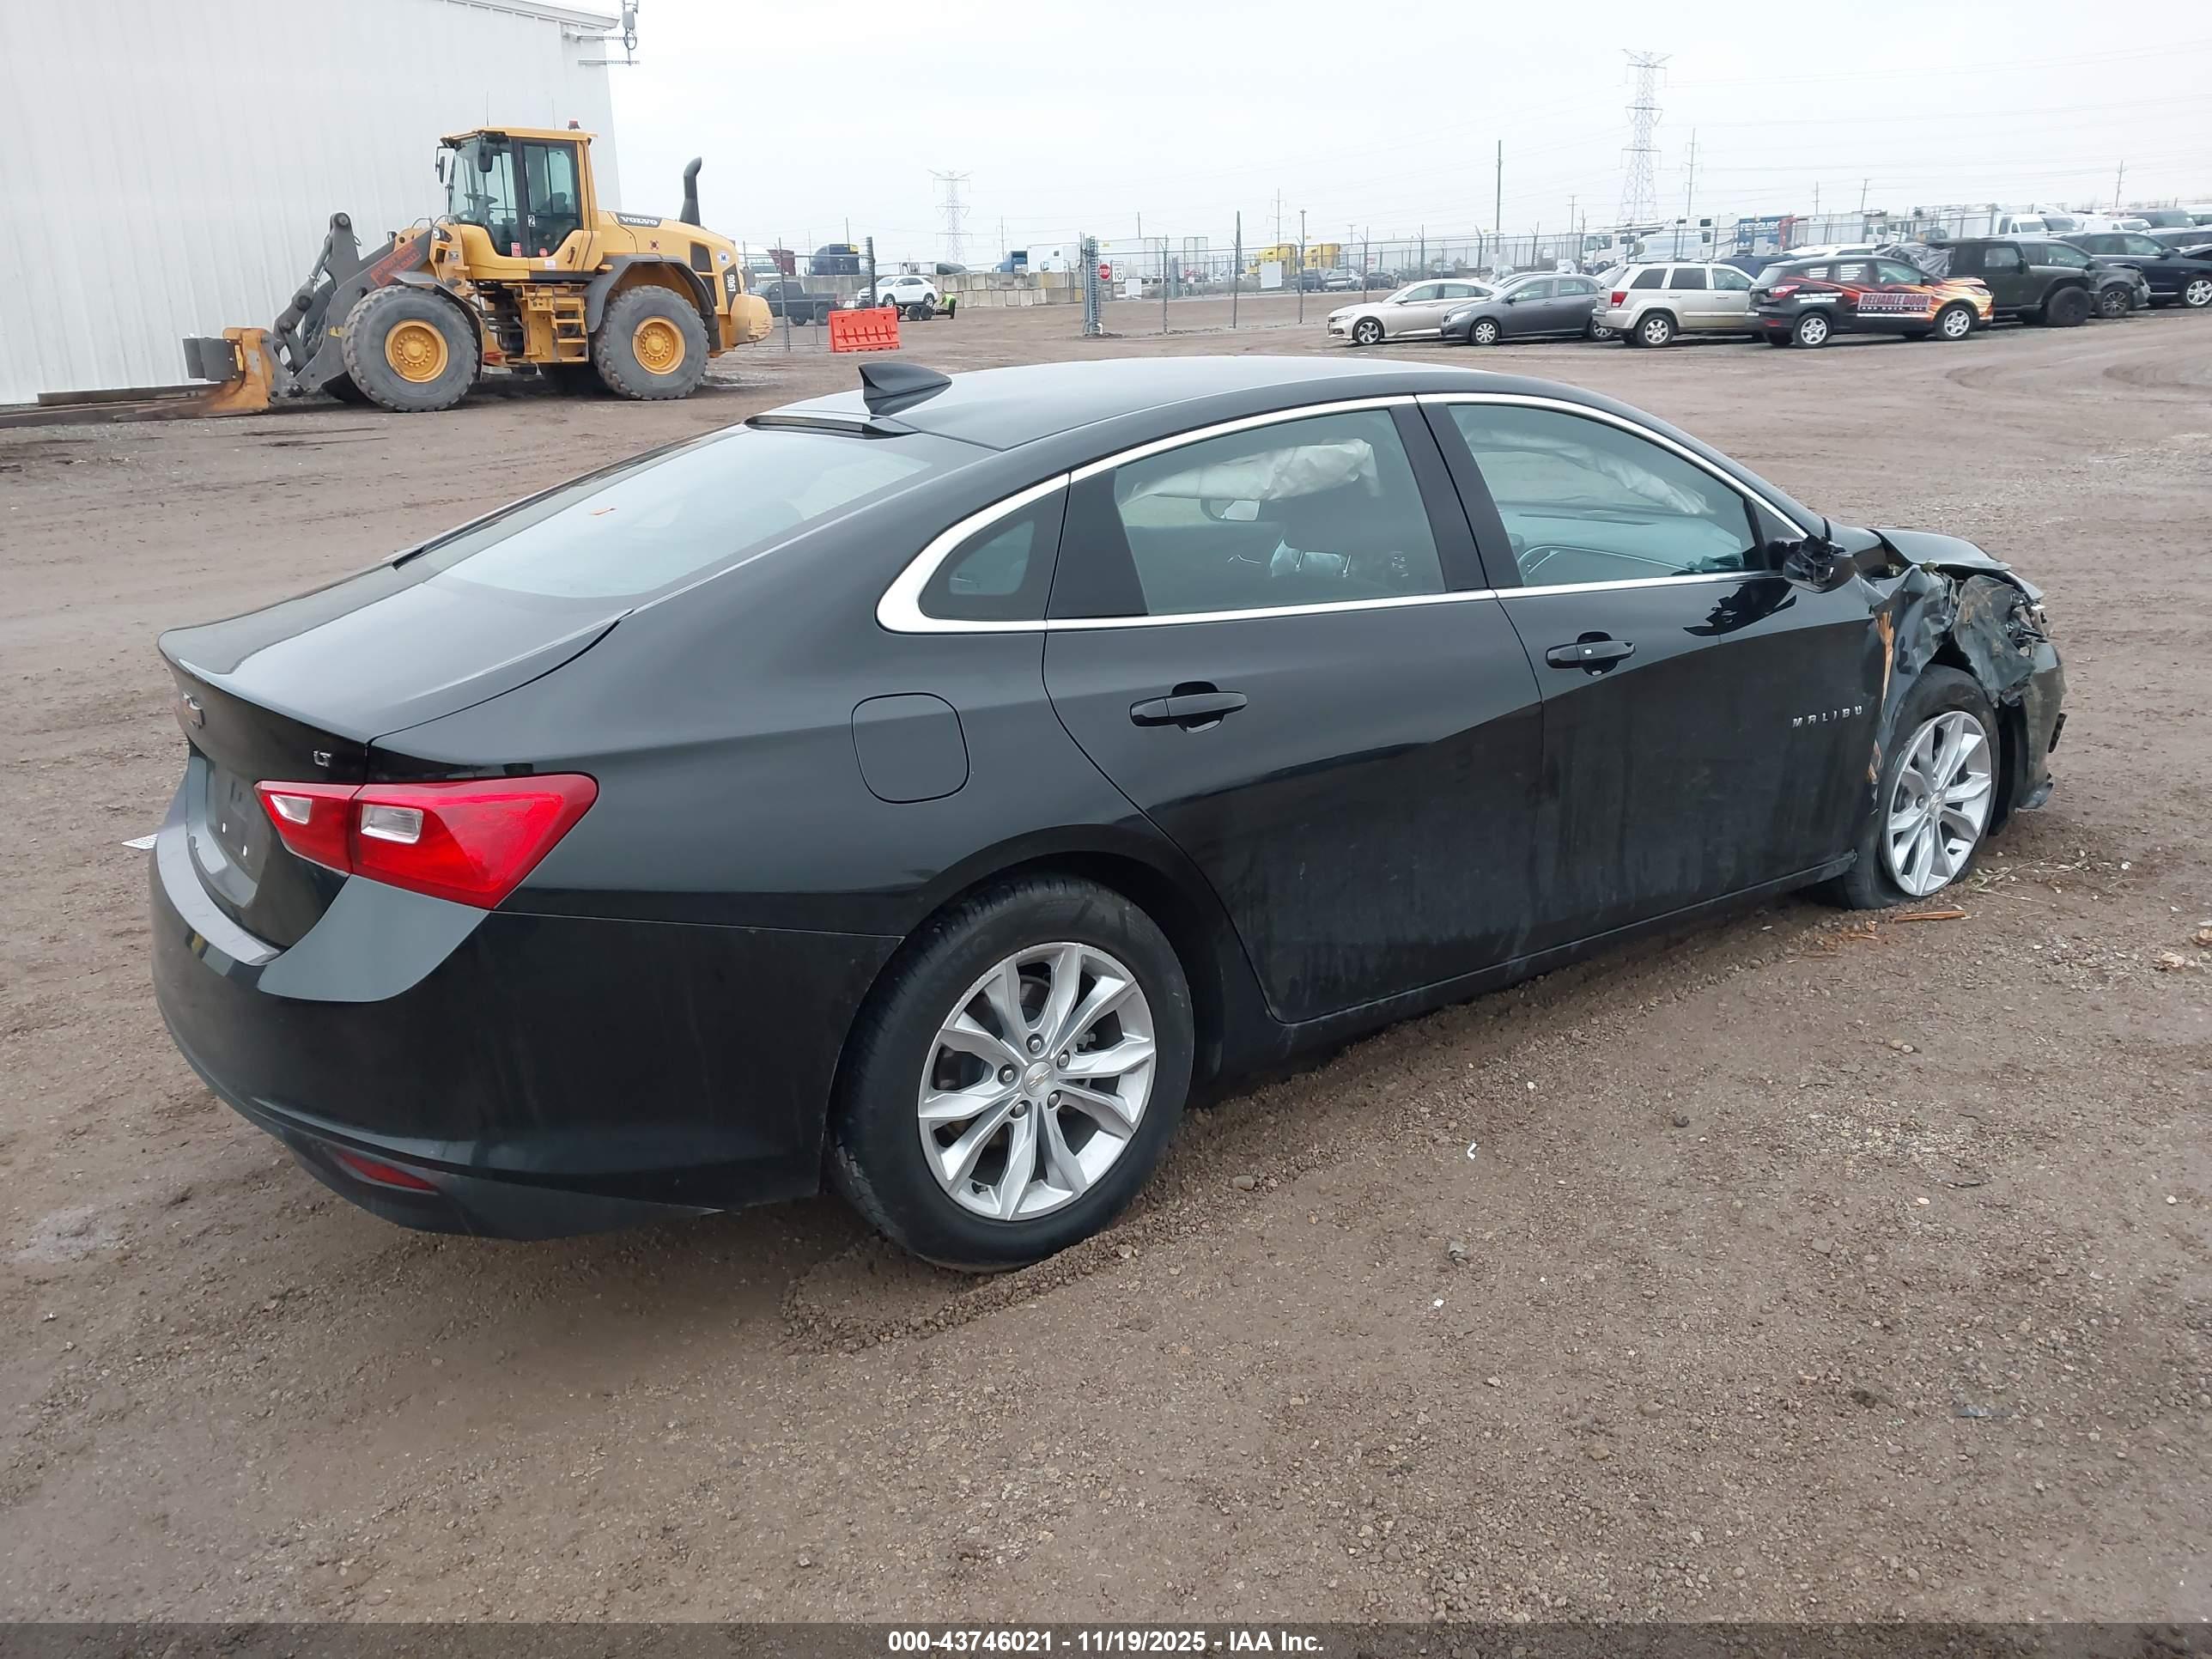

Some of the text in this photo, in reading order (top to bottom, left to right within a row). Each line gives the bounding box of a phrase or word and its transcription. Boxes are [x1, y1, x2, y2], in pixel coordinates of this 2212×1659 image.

[528, 216, 535, 227] 2
[620, 216, 659, 225] VOLVO
[726, 275, 736, 292] L90G
[1861, 295, 1929, 306] RELIABLE DOOR
[1792, 705, 1863, 728] MALIBU
[313, 750, 331, 767] LT
